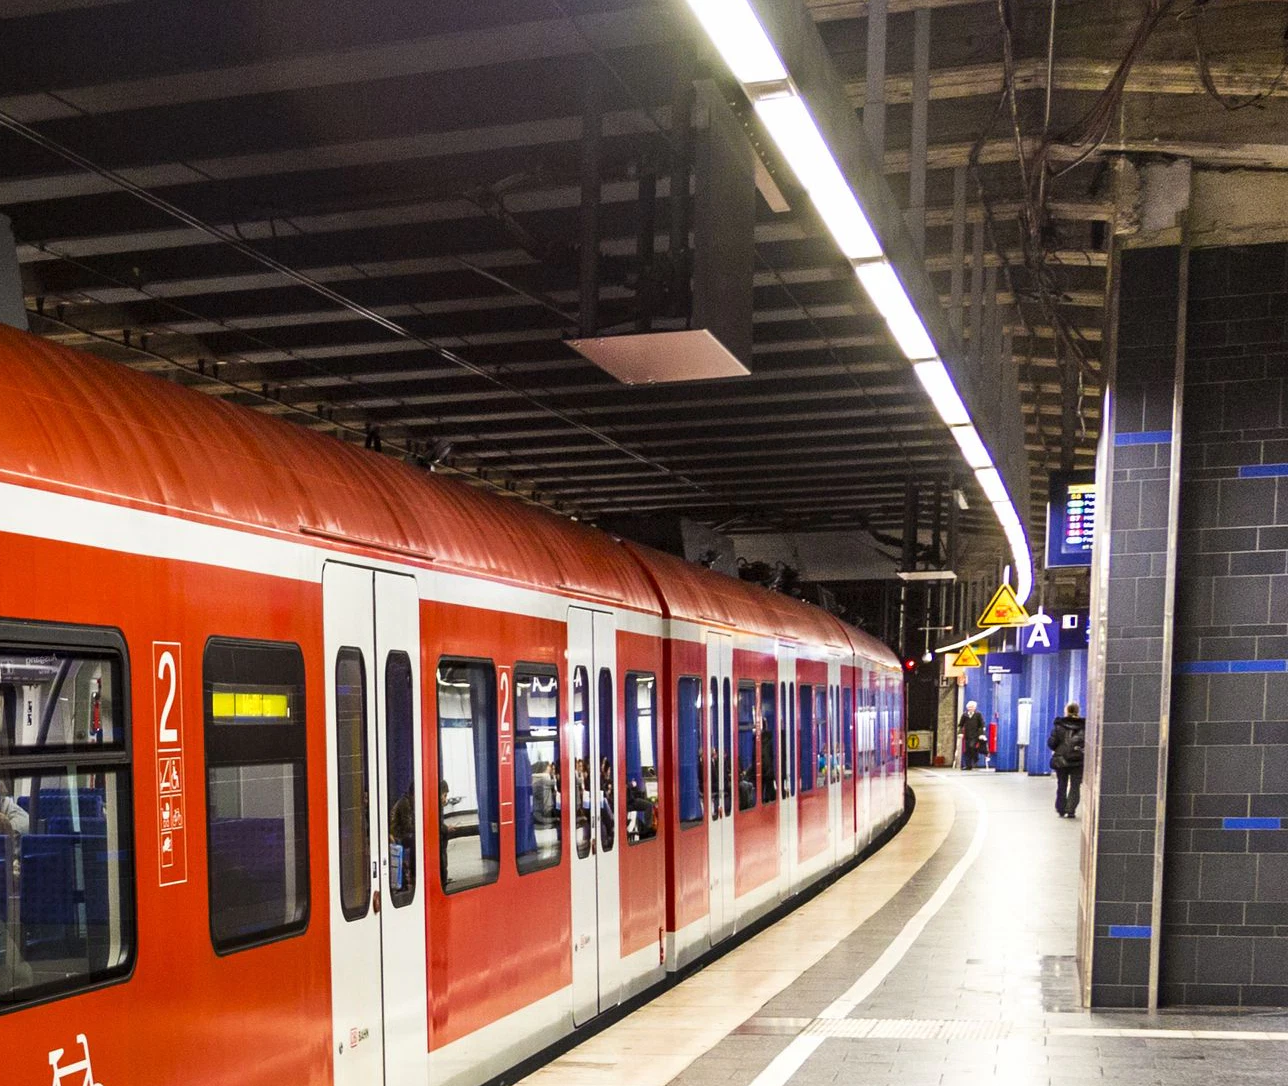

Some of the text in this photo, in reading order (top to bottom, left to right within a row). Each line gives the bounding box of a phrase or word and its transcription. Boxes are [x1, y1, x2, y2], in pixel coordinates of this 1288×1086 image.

[1026, 621, 1051, 648] A
[157, 651, 178, 743] 2
[499, 672, 510, 732] 2
